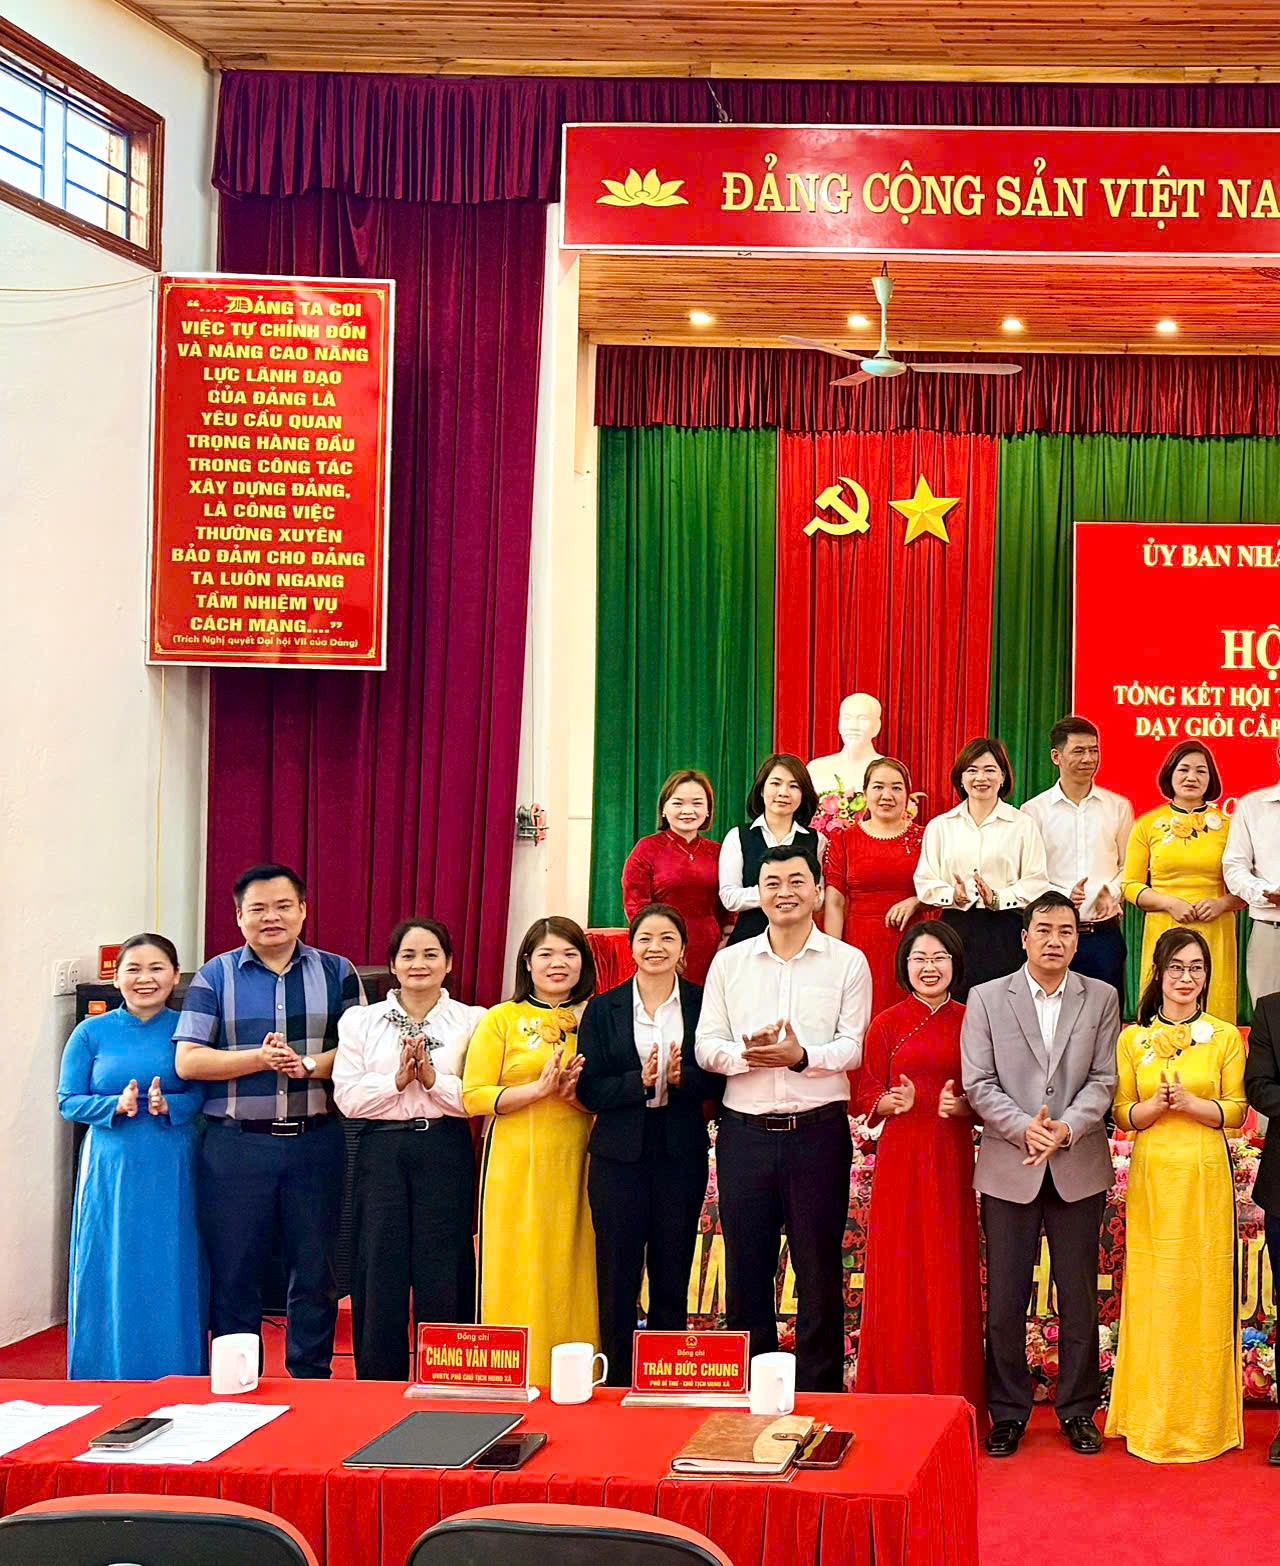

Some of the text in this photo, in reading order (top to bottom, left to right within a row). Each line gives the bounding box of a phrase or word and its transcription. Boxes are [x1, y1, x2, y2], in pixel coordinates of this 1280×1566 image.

[722, 154, 852, 212] ĐẢNG
[864, 161, 984, 224] CỘNG
[997, 158, 1086, 216] SẢN
[1100, 166, 1204, 228] VIỆT
[301, 301, 324, 316] TA
[328, 303, 361, 316] COI
[182, 319, 366, 340] VIỆC TỰ CHỈNH ĐỐN
[178, 343, 368, 361] VÀ NÂNG CAO NĂNG
[204, 367, 341, 386] LỰC LÃNH ĐẠO
[208, 385, 336, 406] CỦA ĐẢNG LÀ
[202, 411, 342, 429] YÊU CẦU QUAN
[188, 434, 354, 452] TRỌNG HÀNG ĐẦU
[189, 458, 352, 475] TRONG CÔNG TÁC
[190, 478, 350, 499] XÂY DỰNG ĐẢNG,
[204, 502, 334, 521] LÀ CÔNG VIỆC
[198, 527, 342, 543] THƯỜNG XUYÊN
[172, 544, 364, 566] BẢO ĐẢM CHO ĐẢNG
[1143, 538, 1177, 566] ỦY
[1182, 545, 1231, 566] BAN
[193, 570, 344, 588] TA LUÔN NGANG
[196, 592, 337, 613] TẦM NHIỆM VỤ
[191, 616, 242, 631] CÁCH
[1114, 681, 1175, 705] TỔNG
[1182, 682, 1225, 705] KẾT
[1230, 684, 1269, 711] HỘI
[1136, 717, 1180, 741] DẠY
[1185, 713, 1233, 736] GIỎI
[1240, 713, 1280, 737] CẤP
[466, 1345, 487, 1367] VĂN
[491, 1350, 520, 1368] MINH
[675, 1360, 697, 1376] ĐỨC
[701, 1363, 739, 1376] CHUNG
